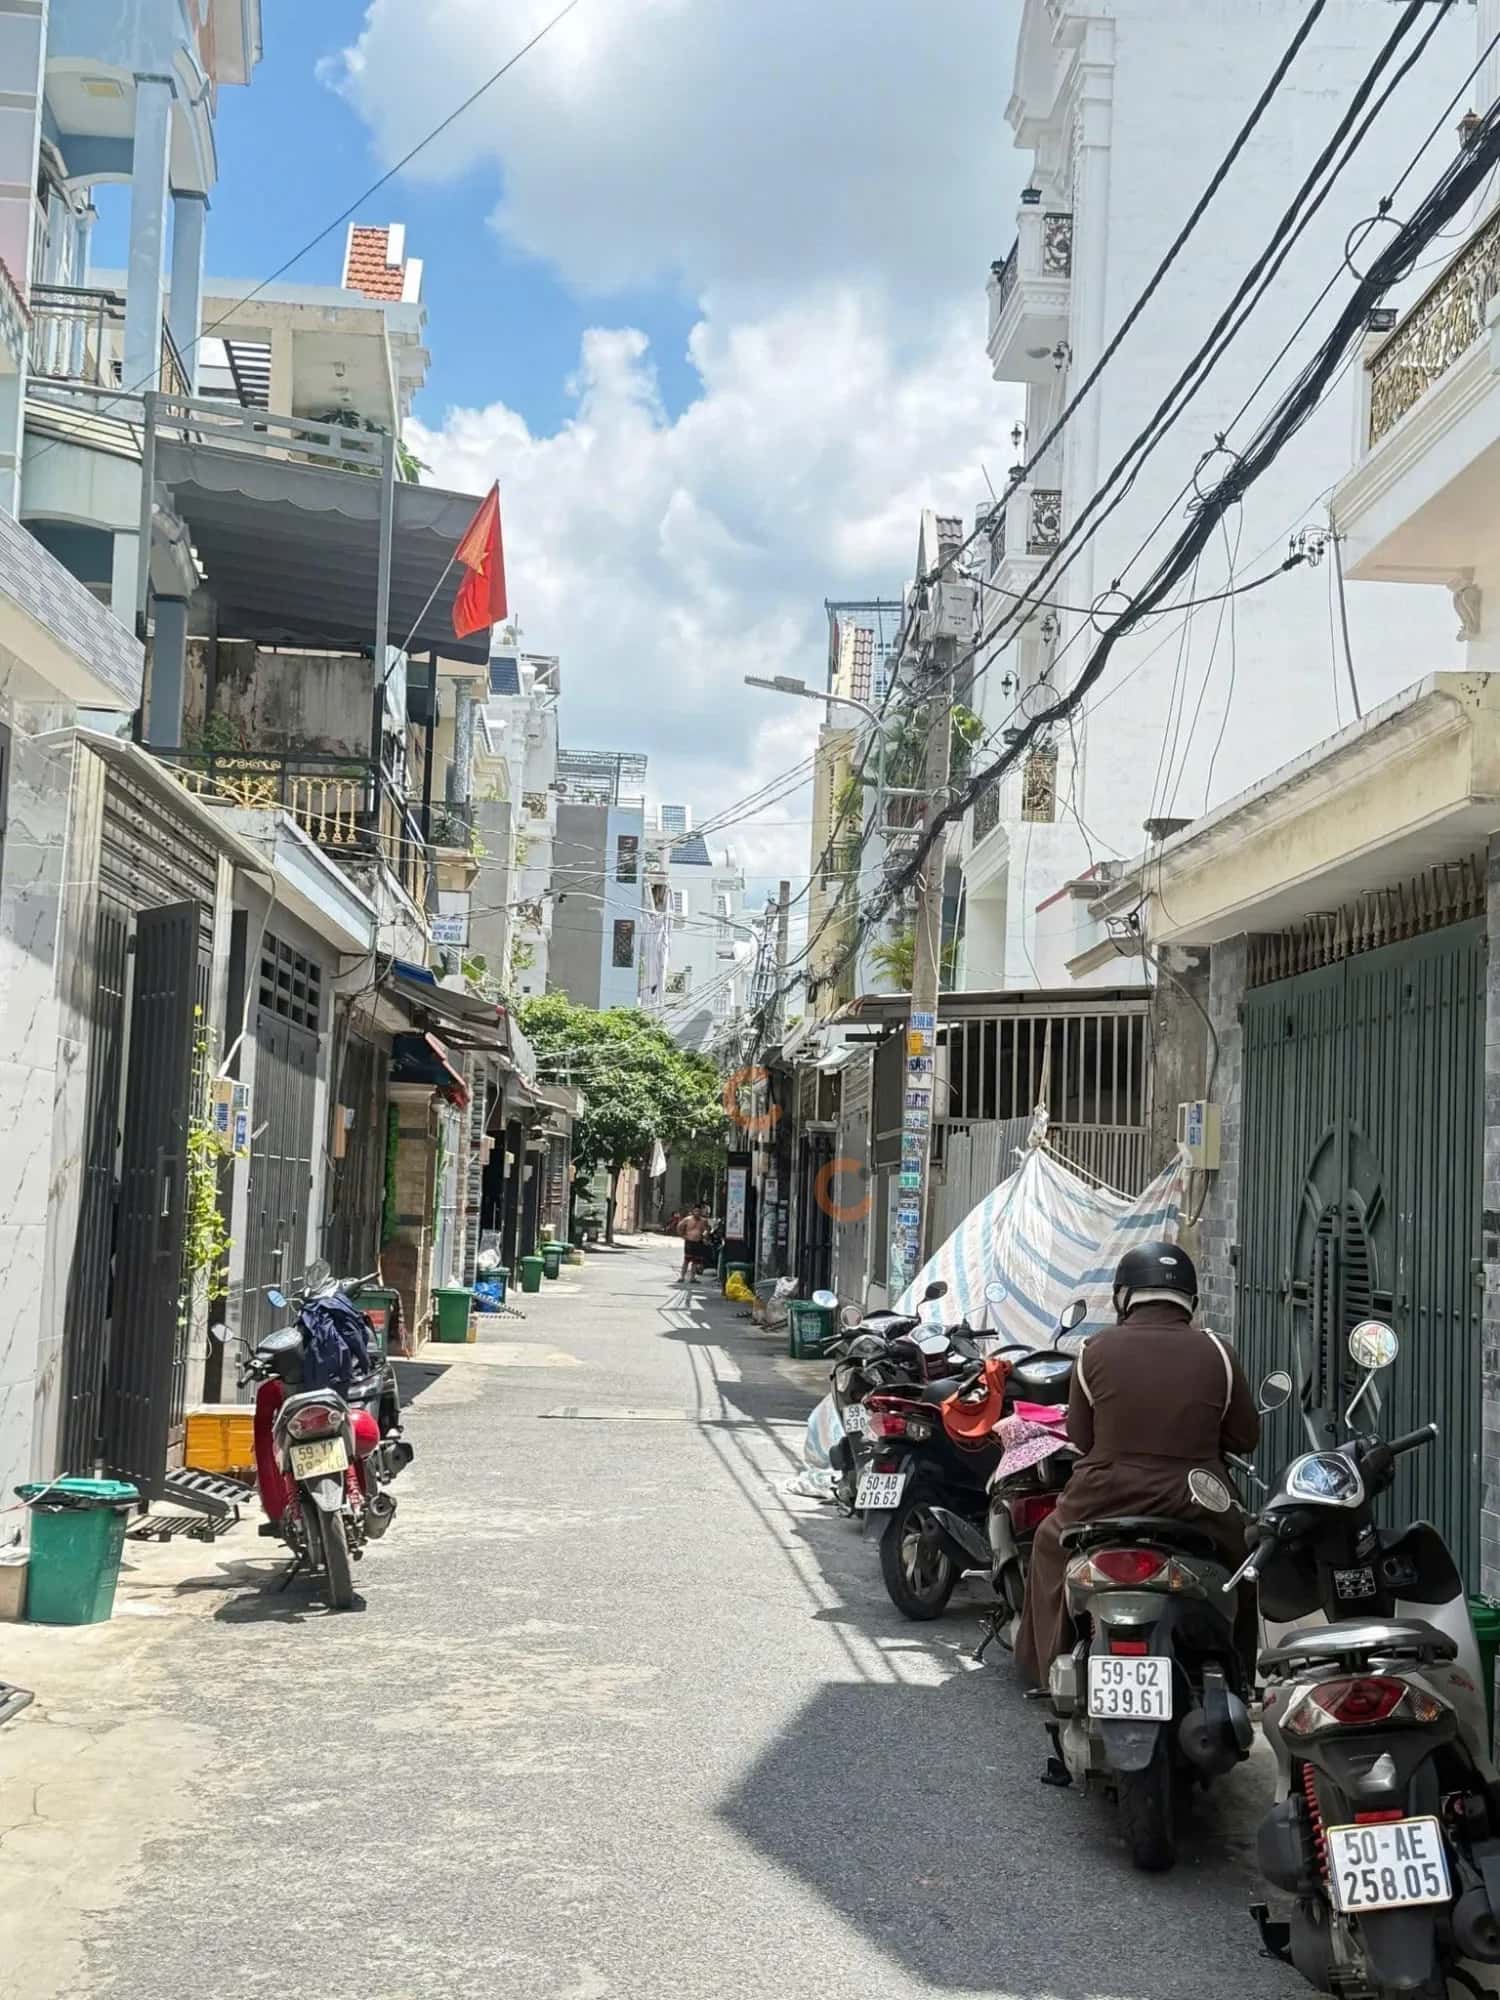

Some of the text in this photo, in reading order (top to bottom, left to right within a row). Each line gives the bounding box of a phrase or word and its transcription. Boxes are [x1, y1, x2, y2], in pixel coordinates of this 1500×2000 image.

[846, 1417, 866, 1431] 530
[848, 1406, 865, 1418] 59-
[866, 1475, 898, 1490] 50-AB
[1101, 1661, 1159, 1687] 59-G2
[1093, 1688, 1163, 1716] 539.61
[1344, 1825, 1427, 1866] 50-AE
[1343, 1862, 1441, 1906] 258.05
